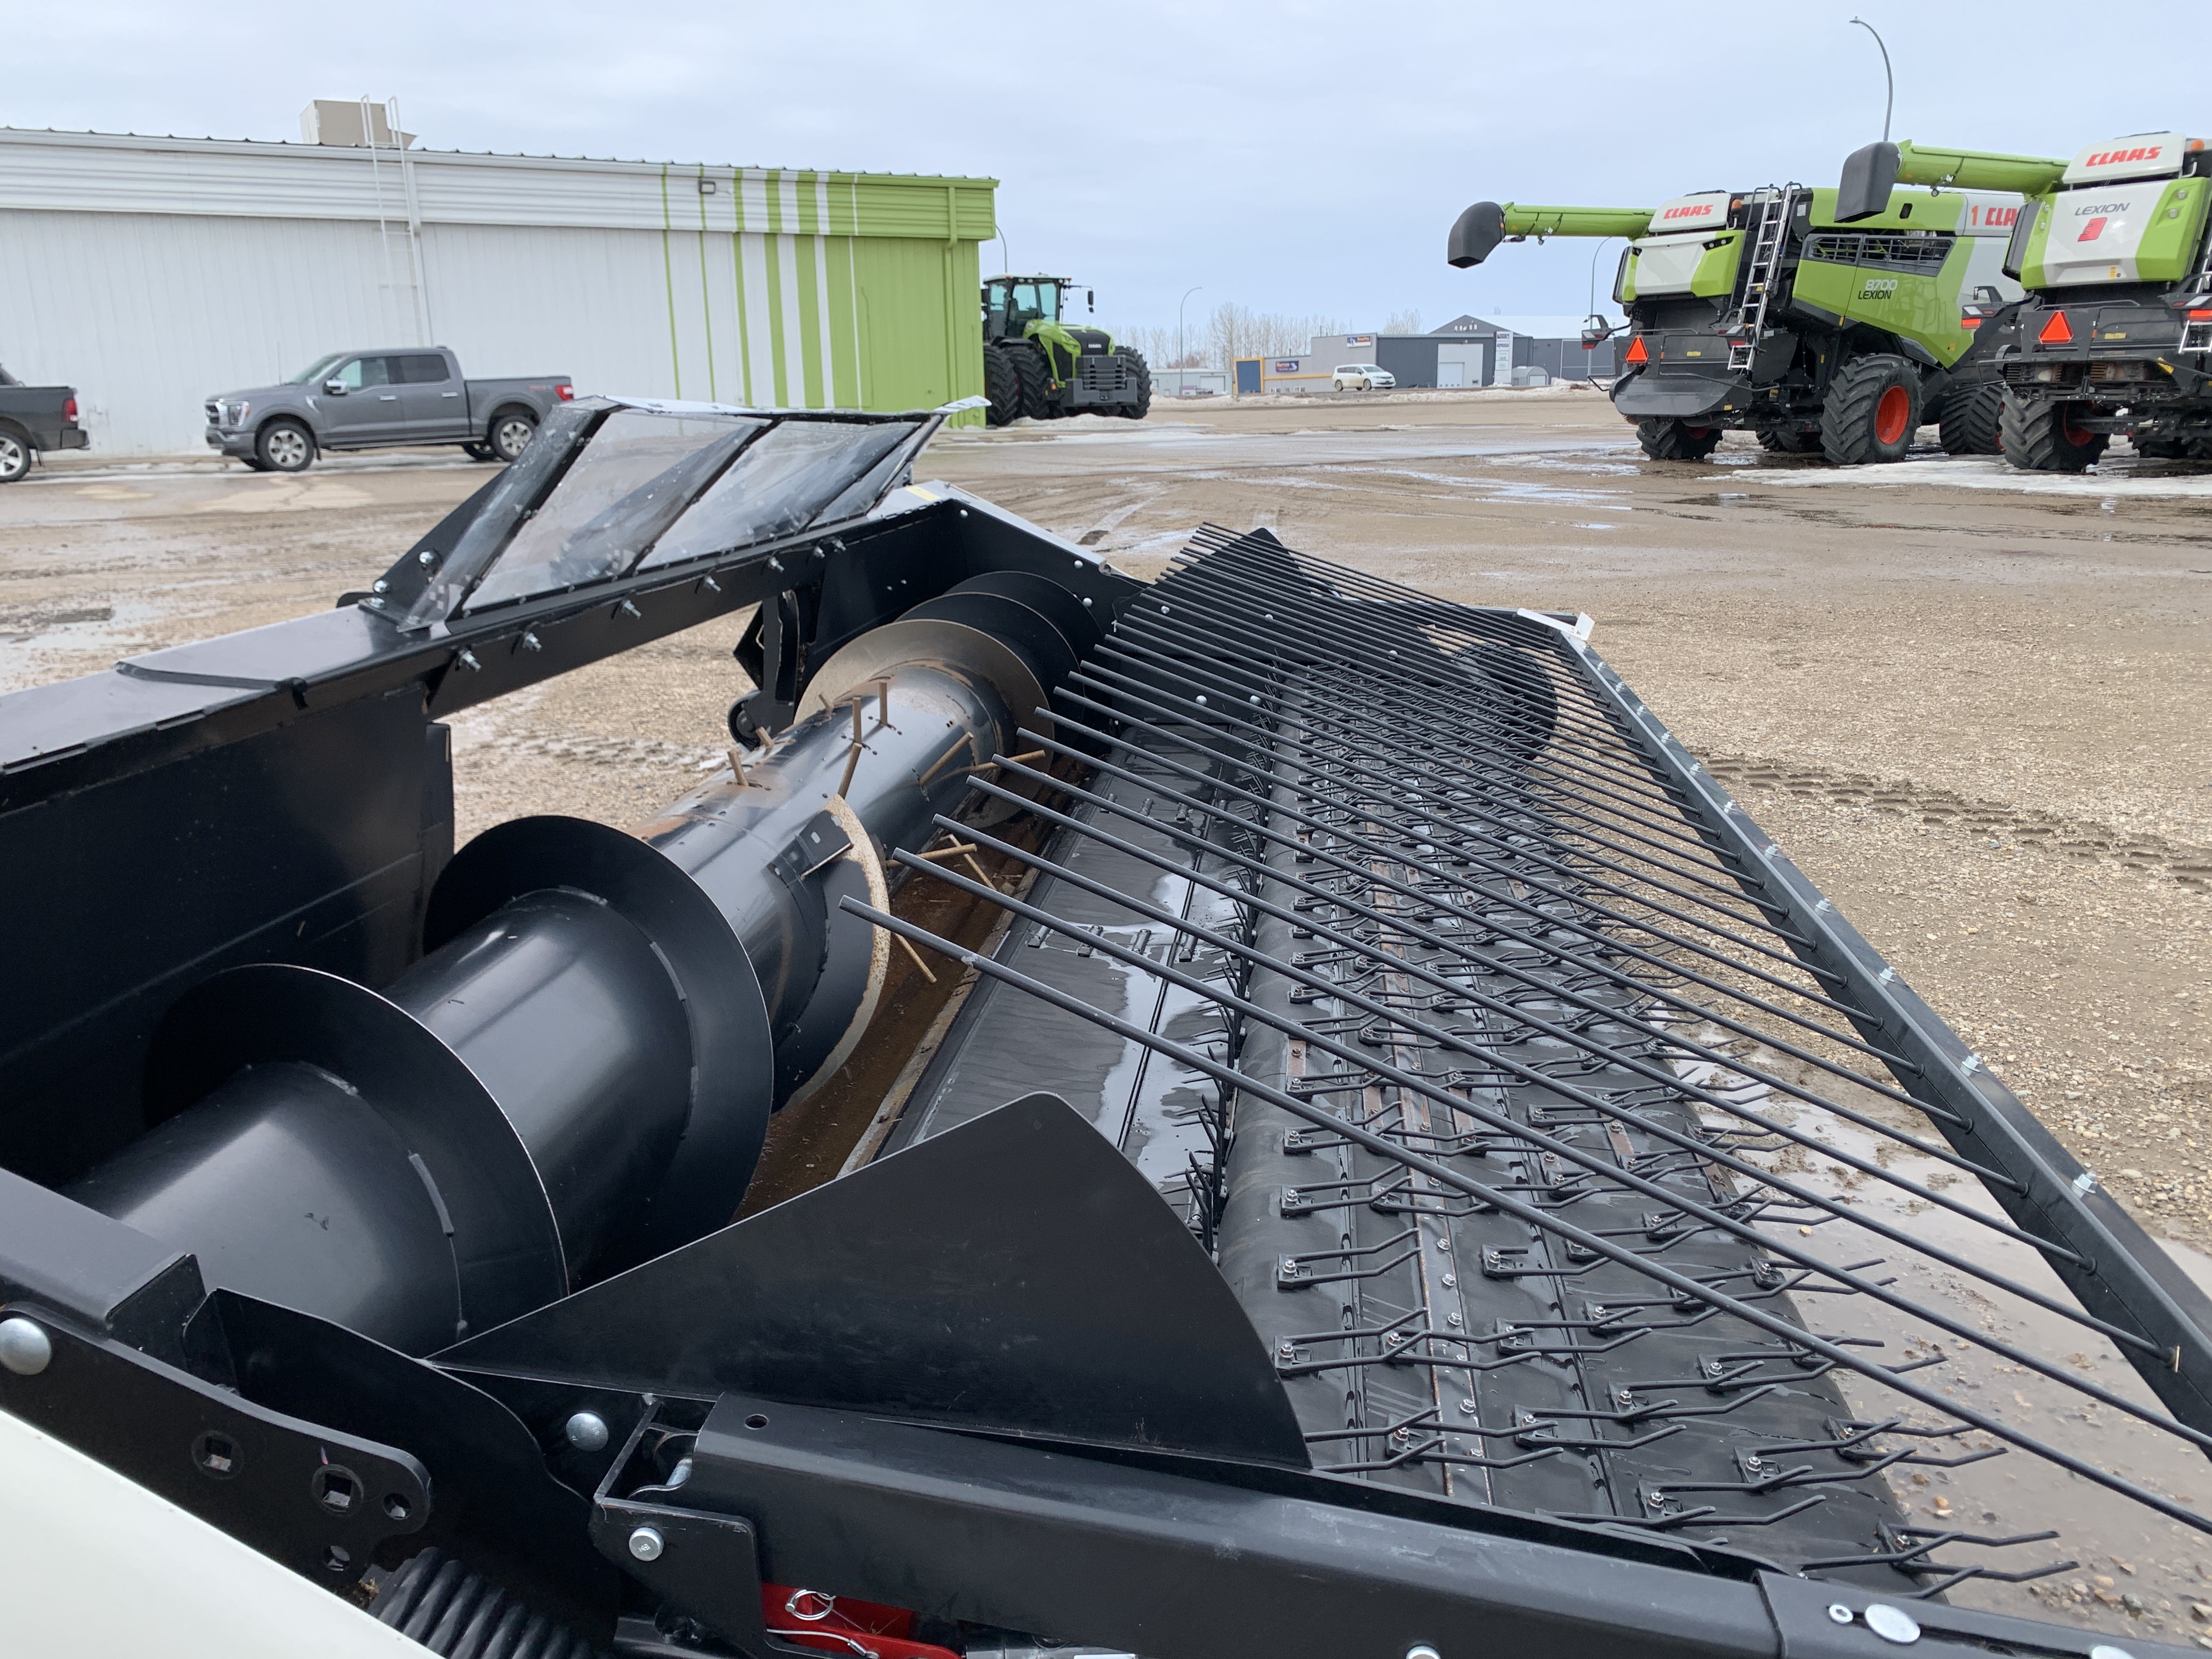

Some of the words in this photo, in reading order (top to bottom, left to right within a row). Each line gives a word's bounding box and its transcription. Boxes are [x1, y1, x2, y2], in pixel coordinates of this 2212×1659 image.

[2086, 146, 2163, 167] CLAAS
[1663, 204, 1714, 219] CLAAS
[2075, 202, 2131, 216] LEXION
[1865, 279, 1898, 290] 8700
[1858, 290, 1892, 300] LEXION
